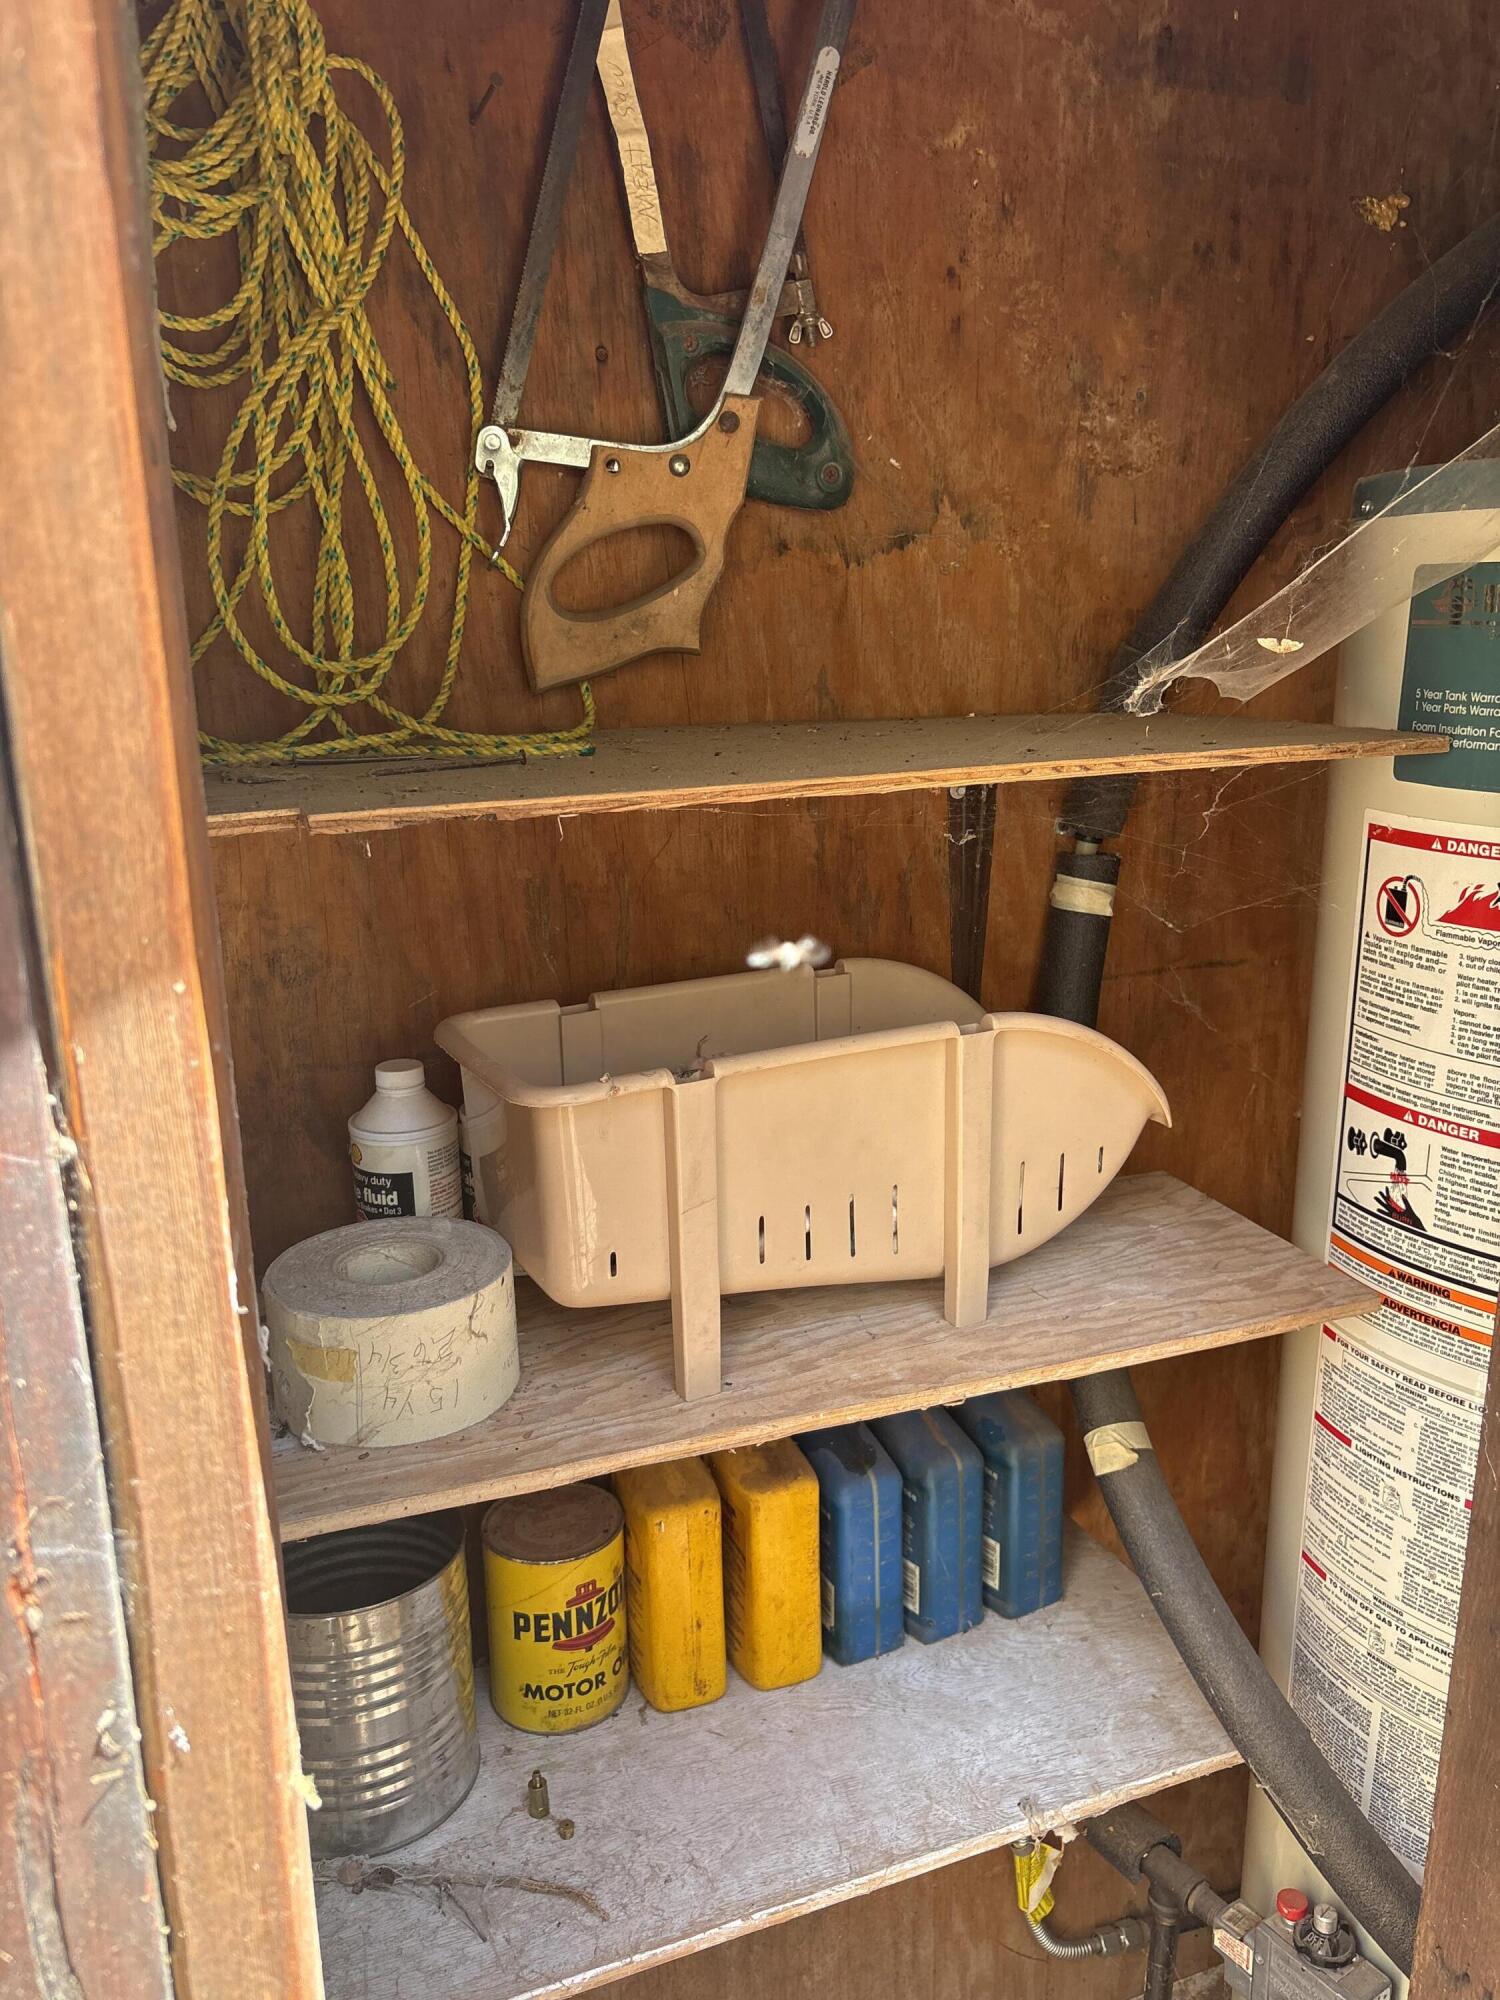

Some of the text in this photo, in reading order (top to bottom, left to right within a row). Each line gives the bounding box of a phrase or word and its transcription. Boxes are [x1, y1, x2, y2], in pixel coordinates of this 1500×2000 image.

[1415, 688, 1421, 698] 5
[1423, 689, 1442, 700] Year
[1445, 690, 1467, 701] Tank
[1415, 701, 1419, 711] 1
[1422, 702, 1441, 712] Year
[1443, 703, 1467, 714] Parts
[1412, 721, 1436, 732] Foam
[1438, 724, 1487, 737] Insulation
[1436, 929, 1475, 943] Flammable
[1373, 933, 1448, 958] Vapors from flammable
[1396, 950, 1423, 962] explode
[1466, 954, 1487, 965] tightly
[1389, 956, 1414, 968] causing
[1416, 962, 1436, 972] death
[1456, 981, 1471, 989] pilot
[1457, 973, 1498, 986] Water heater
[1412, 981, 1444, 995] flammable
[1474, 1000, 1493, 1009] ignite
[1453, 1008, 1477, 1019] Vapors:
[1459, 1019, 1481, 1029] cannot
[1470, 1028, 1494, 1039] heavier
[1457, 1041, 1469, 1049] can
[1472, 1036, 1488, 1046] long
[1464, 1049, 1475, 1057] the
[1476, 1052, 1491, 1061] pilot
[1446, 1075, 1474, 1087] but not
[1447, 1069, 1480, 1081] above the
[1445, 1088, 1467, 1099] burner
[1477, 1095, 1493, 1105] pilot
[1446, 1082, 1490, 1098] vapors being
[1413, 1093, 1438, 1106] warnings
[1451, 1103, 1491, 1119] instructions.
[1420, 1102, 1441, 1113] contact
[1442, 1108, 1452, 1116] the
[1453, 1112, 1476, 1123] retailer
[1417, 1114, 1480, 1141] DANGER
[1442, 1146, 1459, 1155] Water
[1440, 1154, 1486, 1170] cause severe
[1458, 1165, 1473, 1174] from
[370, 1176, 392, 1188] duty
[1439, 1168, 1498, 1190] Children, disabled
[363, 1187, 398, 1206] fluid
[1450, 1188, 1485, 1202] instruction
[1449, 1195, 1488, 1210] temperature
[397, 1207, 402, 1215] 3
[1469, 1210, 1489, 1220] before
[1434, 1214, 1476, 1232] Temperature
[1441, 1248, 1476, 1262] thermostat
[1477, 1259, 1498, 1269] which
[1397, 1270, 1450, 1299] WARNING
[1383, 1298, 1460, 1337] ADVERTENCIA
[1337, 1338, 1349, 1349] FOR
[1350, 1346, 1369, 1362] YOUR
[1371, 1359, 1400, 1378] SAFETY
[1402, 1375, 1426, 1390] READ
[1428, 1386, 1466, 1407] BEFORE
[1395, 1382, 1427, 1402] WARNING
[1355, 1443, 1461, 1502] LIGHTING INSTRUCTIONS
[1329, 1577, 1338, 1588] TO
[1339, 1586, 1358, 1604] TURN
[1359, 1602, 1374, 1614] OFF
[1375, 1613, 1392, 1627] GAS
[1394, 1624, 1407, 1635] TO
[1372, 1595, 1404, 1617] WARNING
[1366, 1651, 1397, 1674] WARNING
[523, 1671, 608, 1701] MOTOR
[1308, 1932, 1326, 1946] OFF
